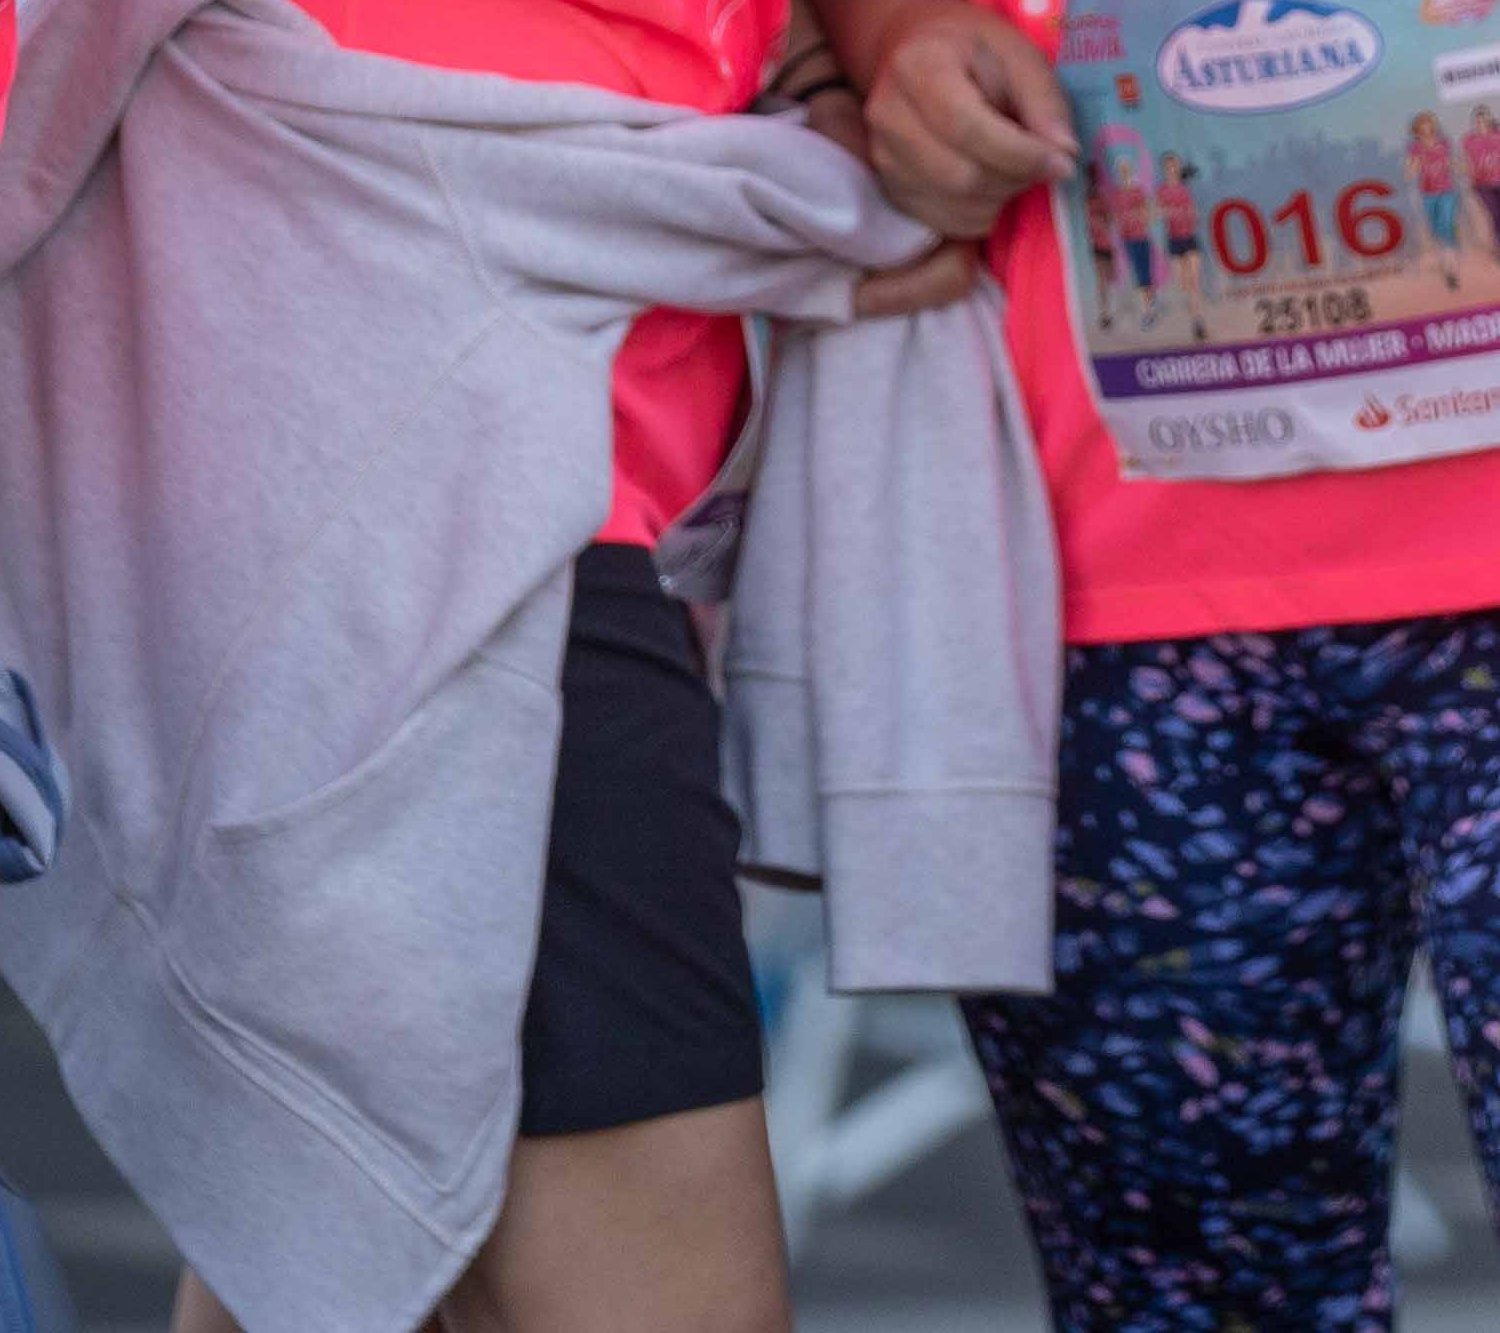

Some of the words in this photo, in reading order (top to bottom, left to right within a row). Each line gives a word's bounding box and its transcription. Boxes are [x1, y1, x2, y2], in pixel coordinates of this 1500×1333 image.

[1210, 179, 1404, 276] 016
[1254, 285, 1373, 334] 25108
[1135, 353, 1238, 389] CARRERA
[1242, 348, 1273, 379] DE
[1276, 345, 1314, 376] LA
[1314, 330, 1409, 371] MUJER
[1148, 407, 1294, 454] OYSHO
